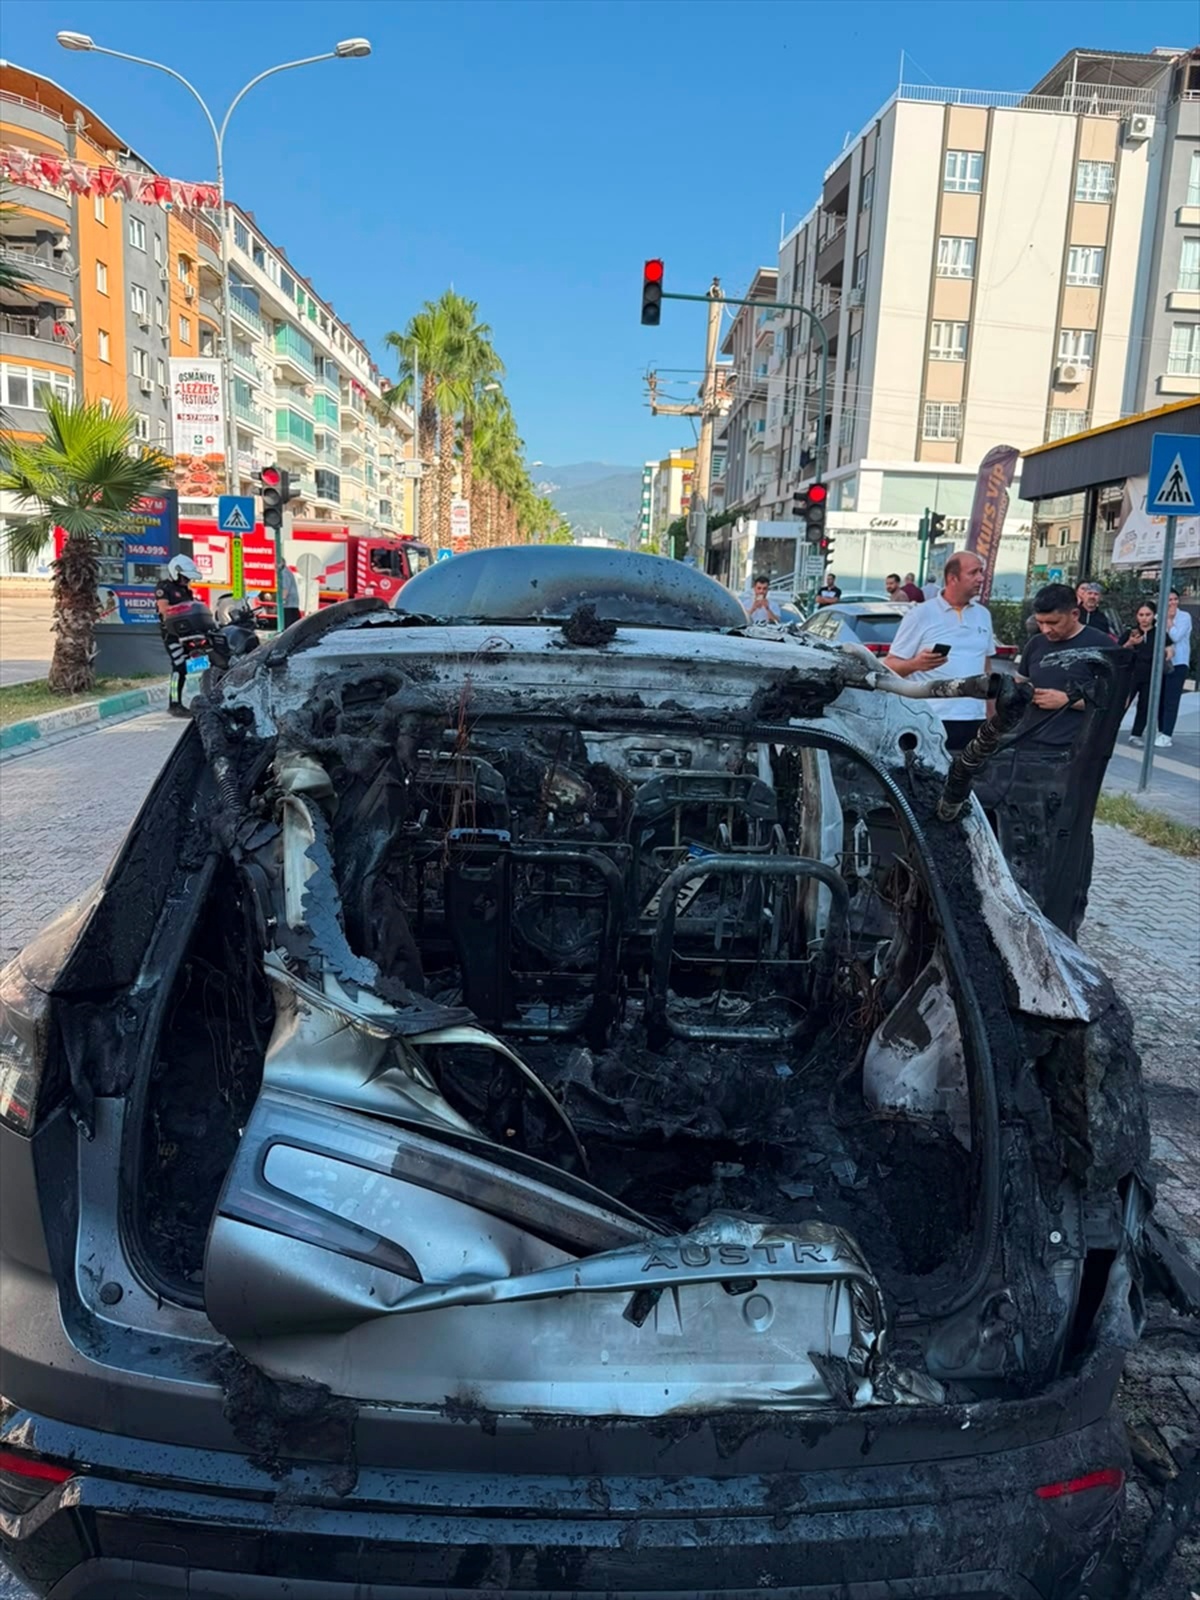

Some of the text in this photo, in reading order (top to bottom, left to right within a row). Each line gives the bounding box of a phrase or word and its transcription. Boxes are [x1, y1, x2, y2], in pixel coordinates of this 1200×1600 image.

[178, 371, 216, 384] OSMANİYE
[181, 383, 213, 394] LEZZET
[197, 556, 211, 568] 112
[125, 597, 157, 608] HEDİY
